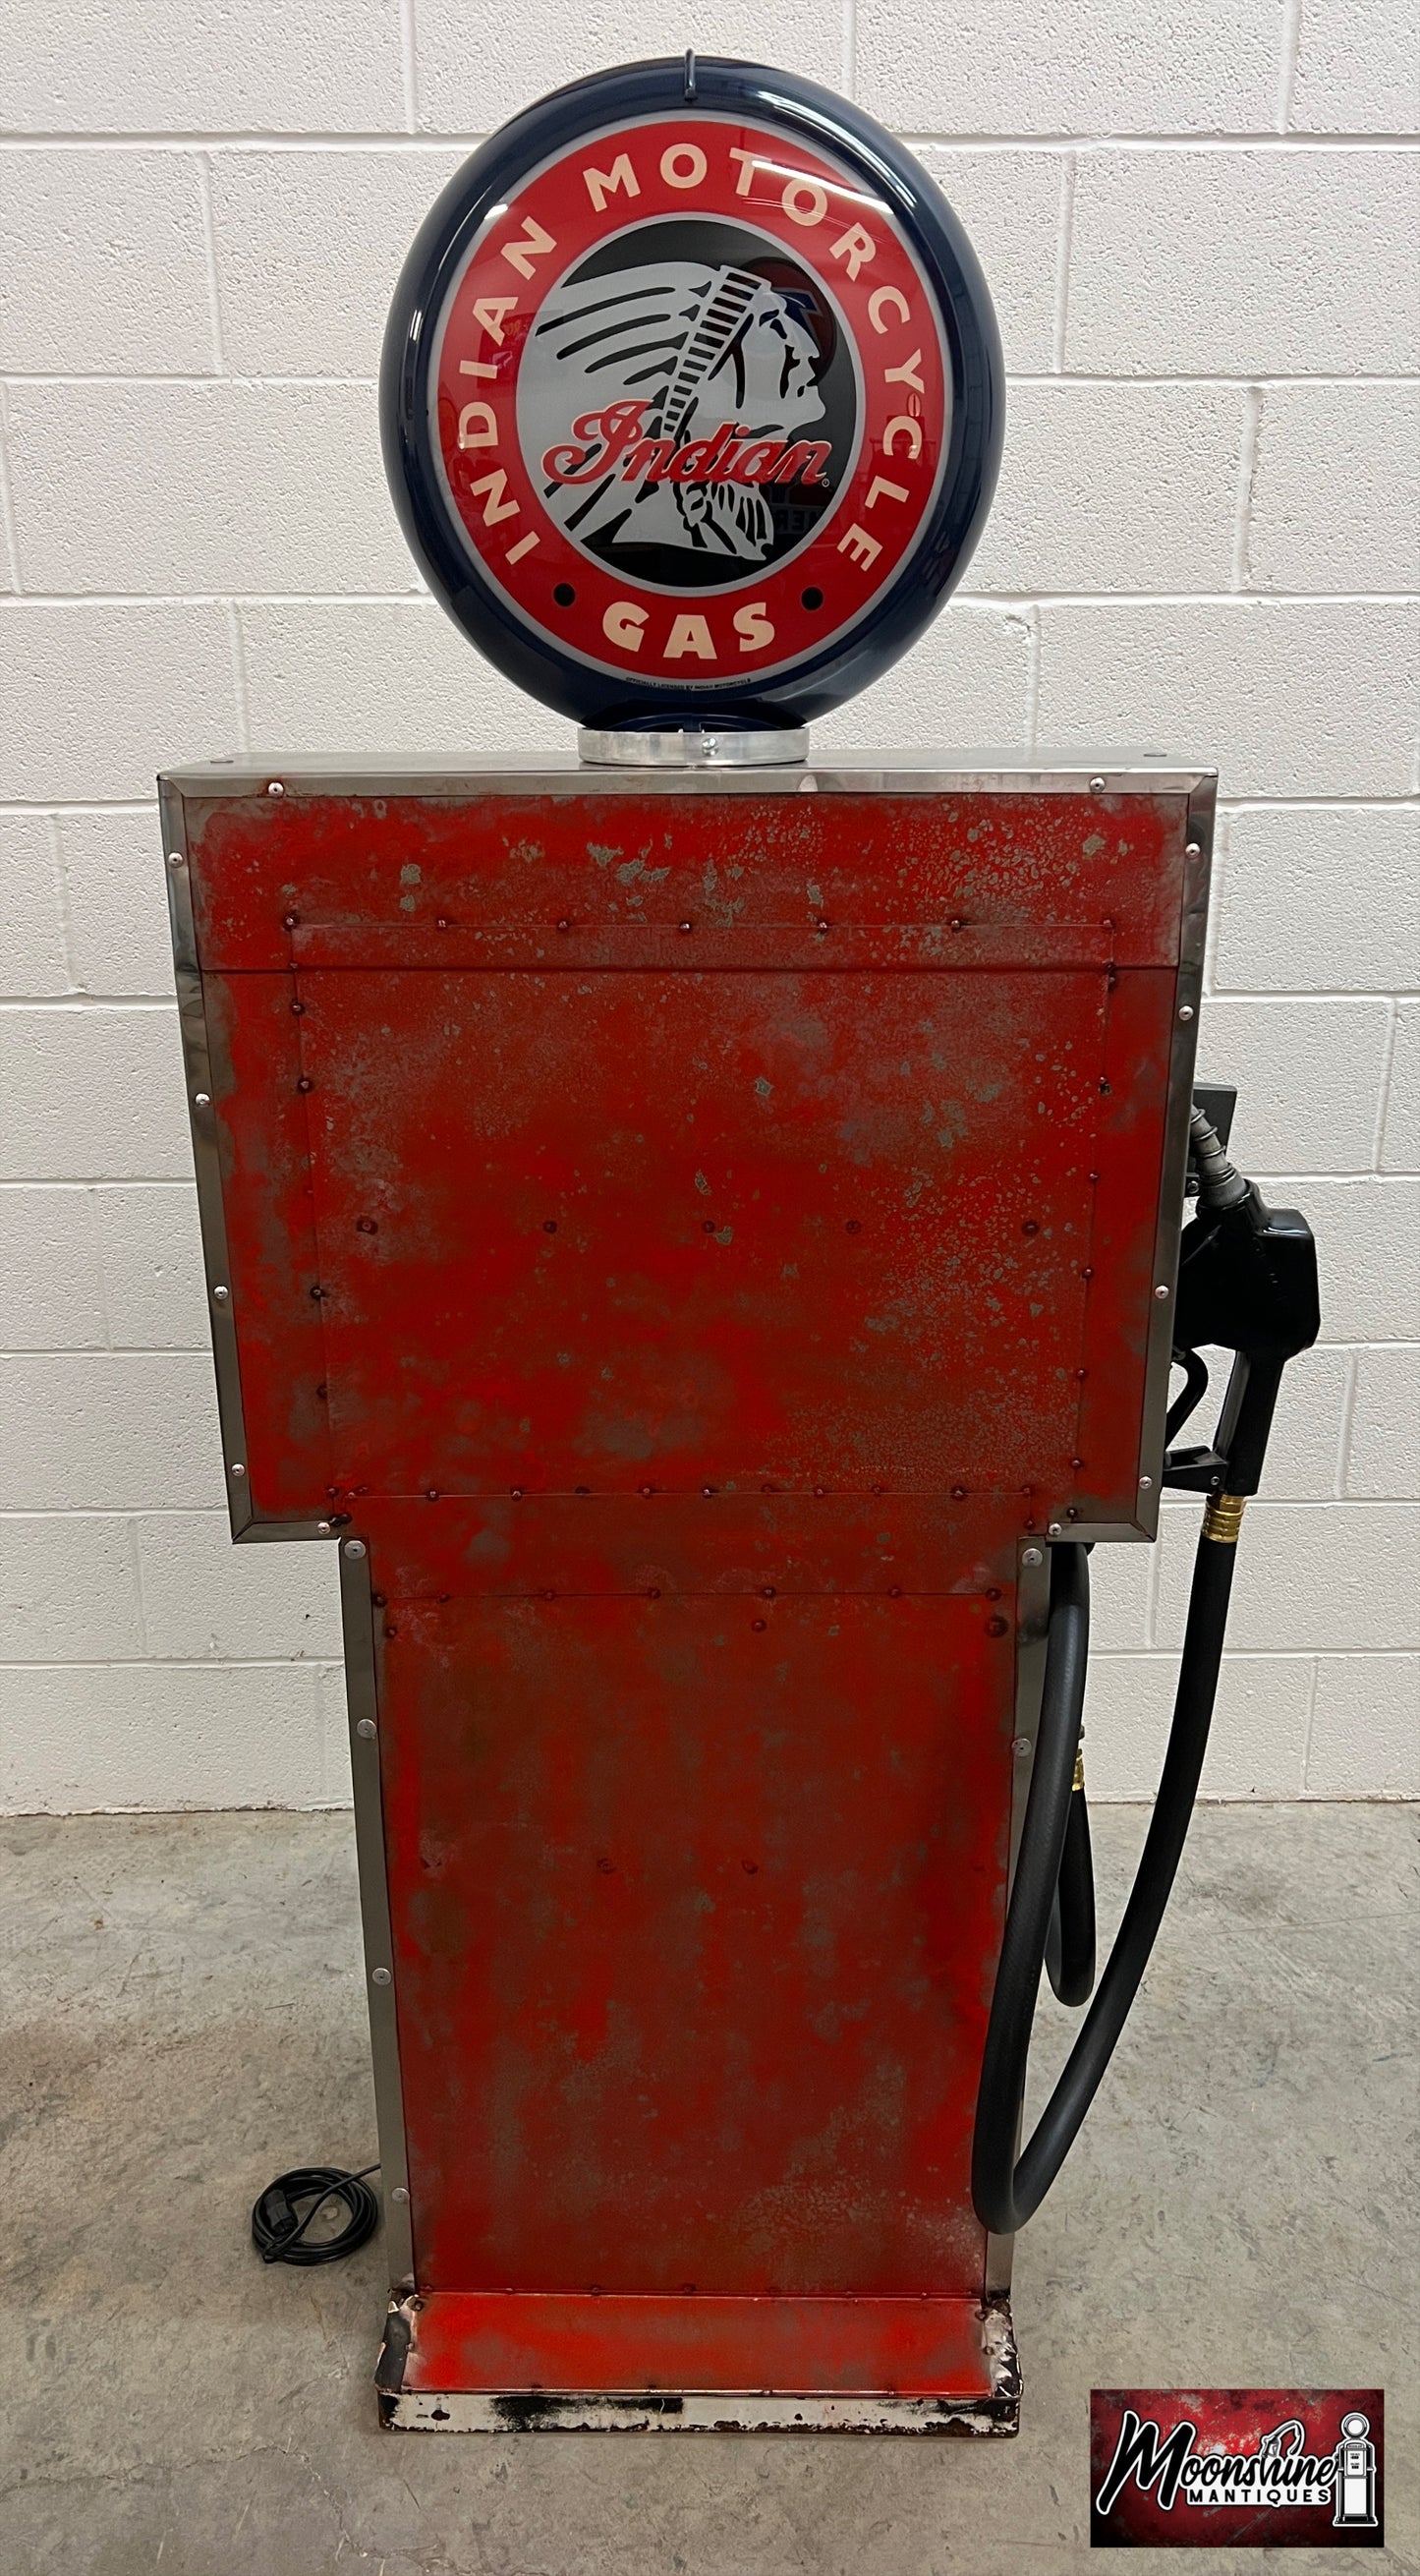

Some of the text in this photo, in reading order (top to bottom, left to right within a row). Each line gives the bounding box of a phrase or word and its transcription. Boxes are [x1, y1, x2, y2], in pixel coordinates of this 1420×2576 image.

[458, 143, 926, 571] INDIAN MOTORCYCLE
[542, 399, 833, 485] Indian
[602, 601, 775, 659] GAS
